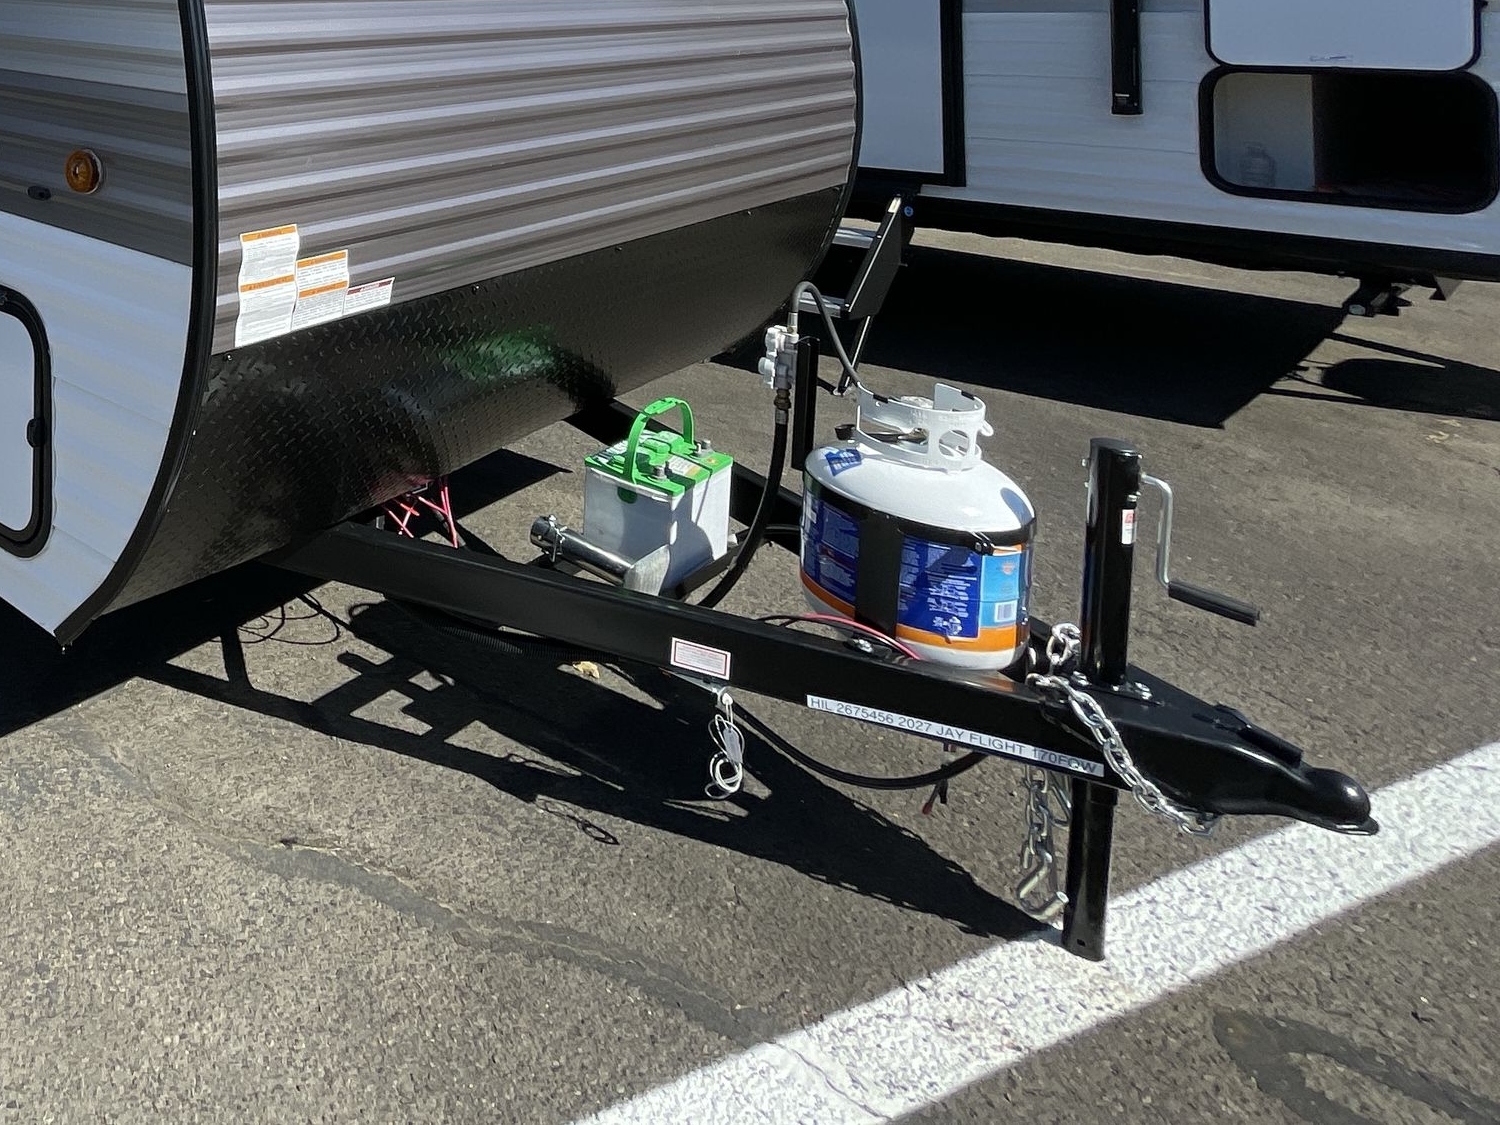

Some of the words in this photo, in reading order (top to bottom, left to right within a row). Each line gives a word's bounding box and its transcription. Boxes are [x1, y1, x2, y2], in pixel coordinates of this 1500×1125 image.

[810, 697, 833, 712] HIL
[836, 702, 895, 724] 2675456
[898, 716, 932, 732] 2027
[936, 726, 965, 741] JAY
[969, 733, 1026, 755] FLIGHT
[1032, 747, 1097, 774] 170FQW
